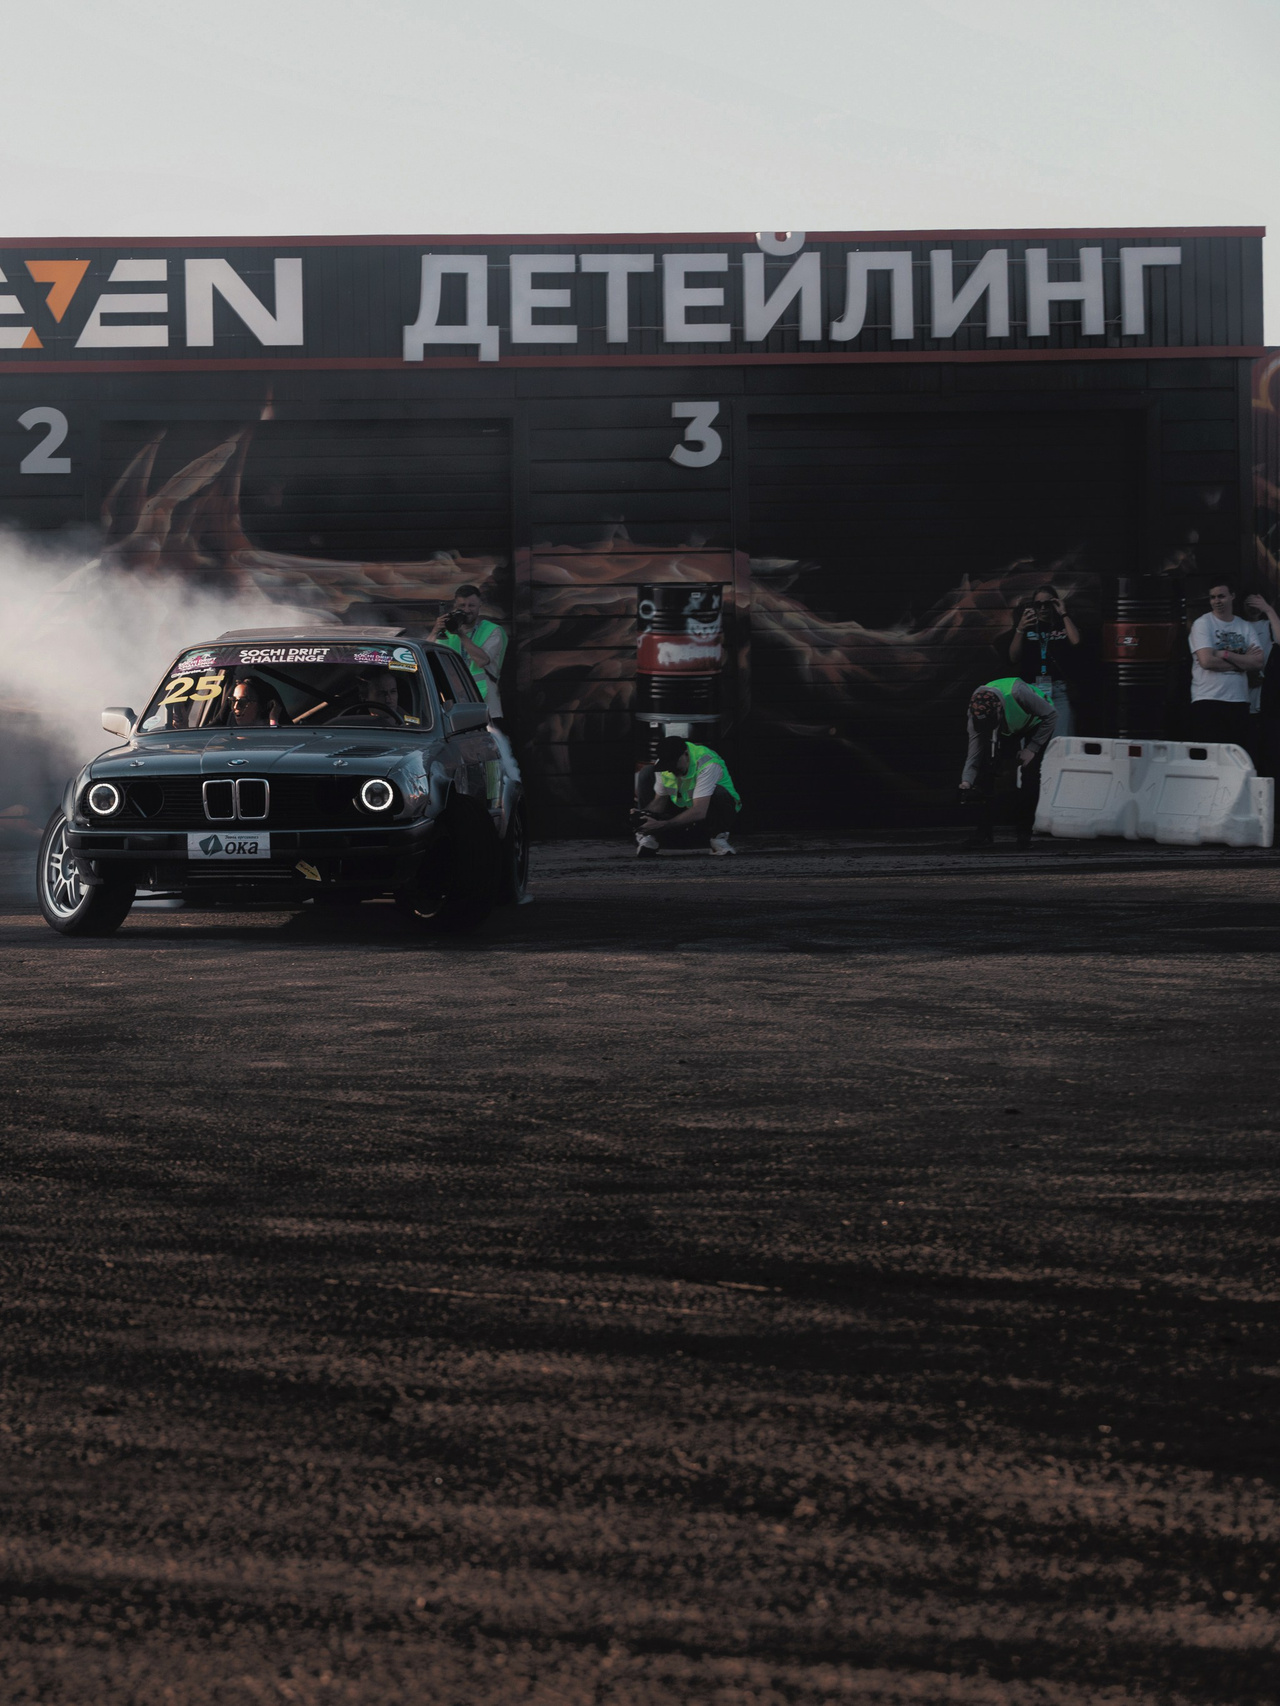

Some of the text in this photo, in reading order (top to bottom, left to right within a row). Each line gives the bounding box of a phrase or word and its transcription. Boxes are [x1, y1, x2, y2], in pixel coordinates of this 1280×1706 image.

[402, 231, 1182, 361] ДЕТЕЙЛИНГ
[17, 406, 71, 475] 2
[669, 401, 723, 468] 3
[239, 647, 330, 658] SOCHI DRIFT
[240, 655, 325, 664] CHALLENGE
[158, 674, 225, 706] 25
